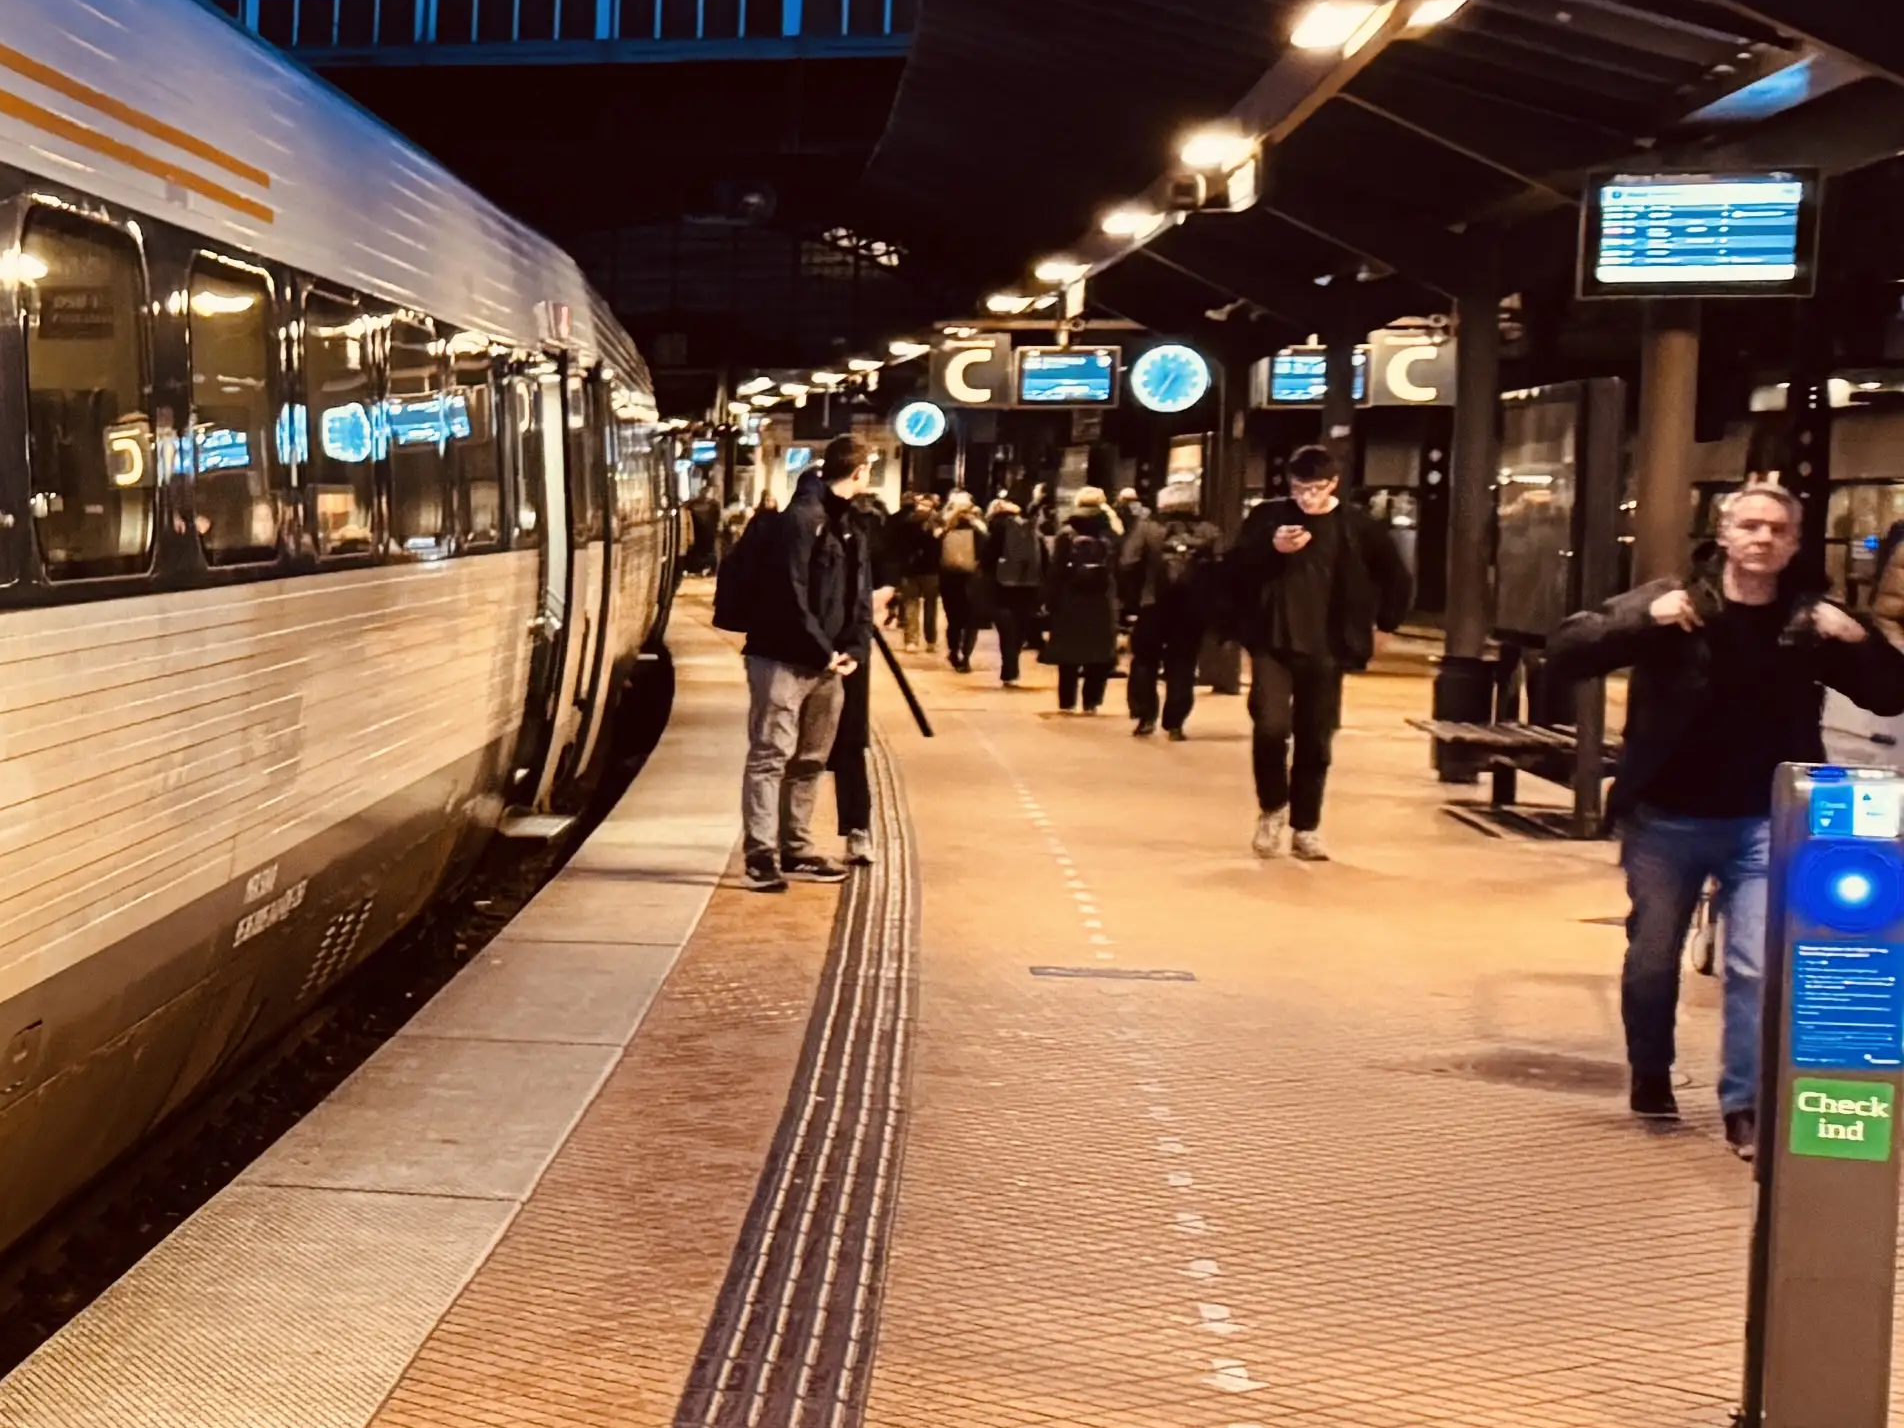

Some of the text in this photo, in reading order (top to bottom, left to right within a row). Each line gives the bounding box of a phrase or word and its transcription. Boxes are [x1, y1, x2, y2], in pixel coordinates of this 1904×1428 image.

[944, 348, 992, 403] C
[1385, 346, 1438, 402] C
[1797, 1090, 1891, 1118] Check
[1817, 1117, 1865, 1142] ind
